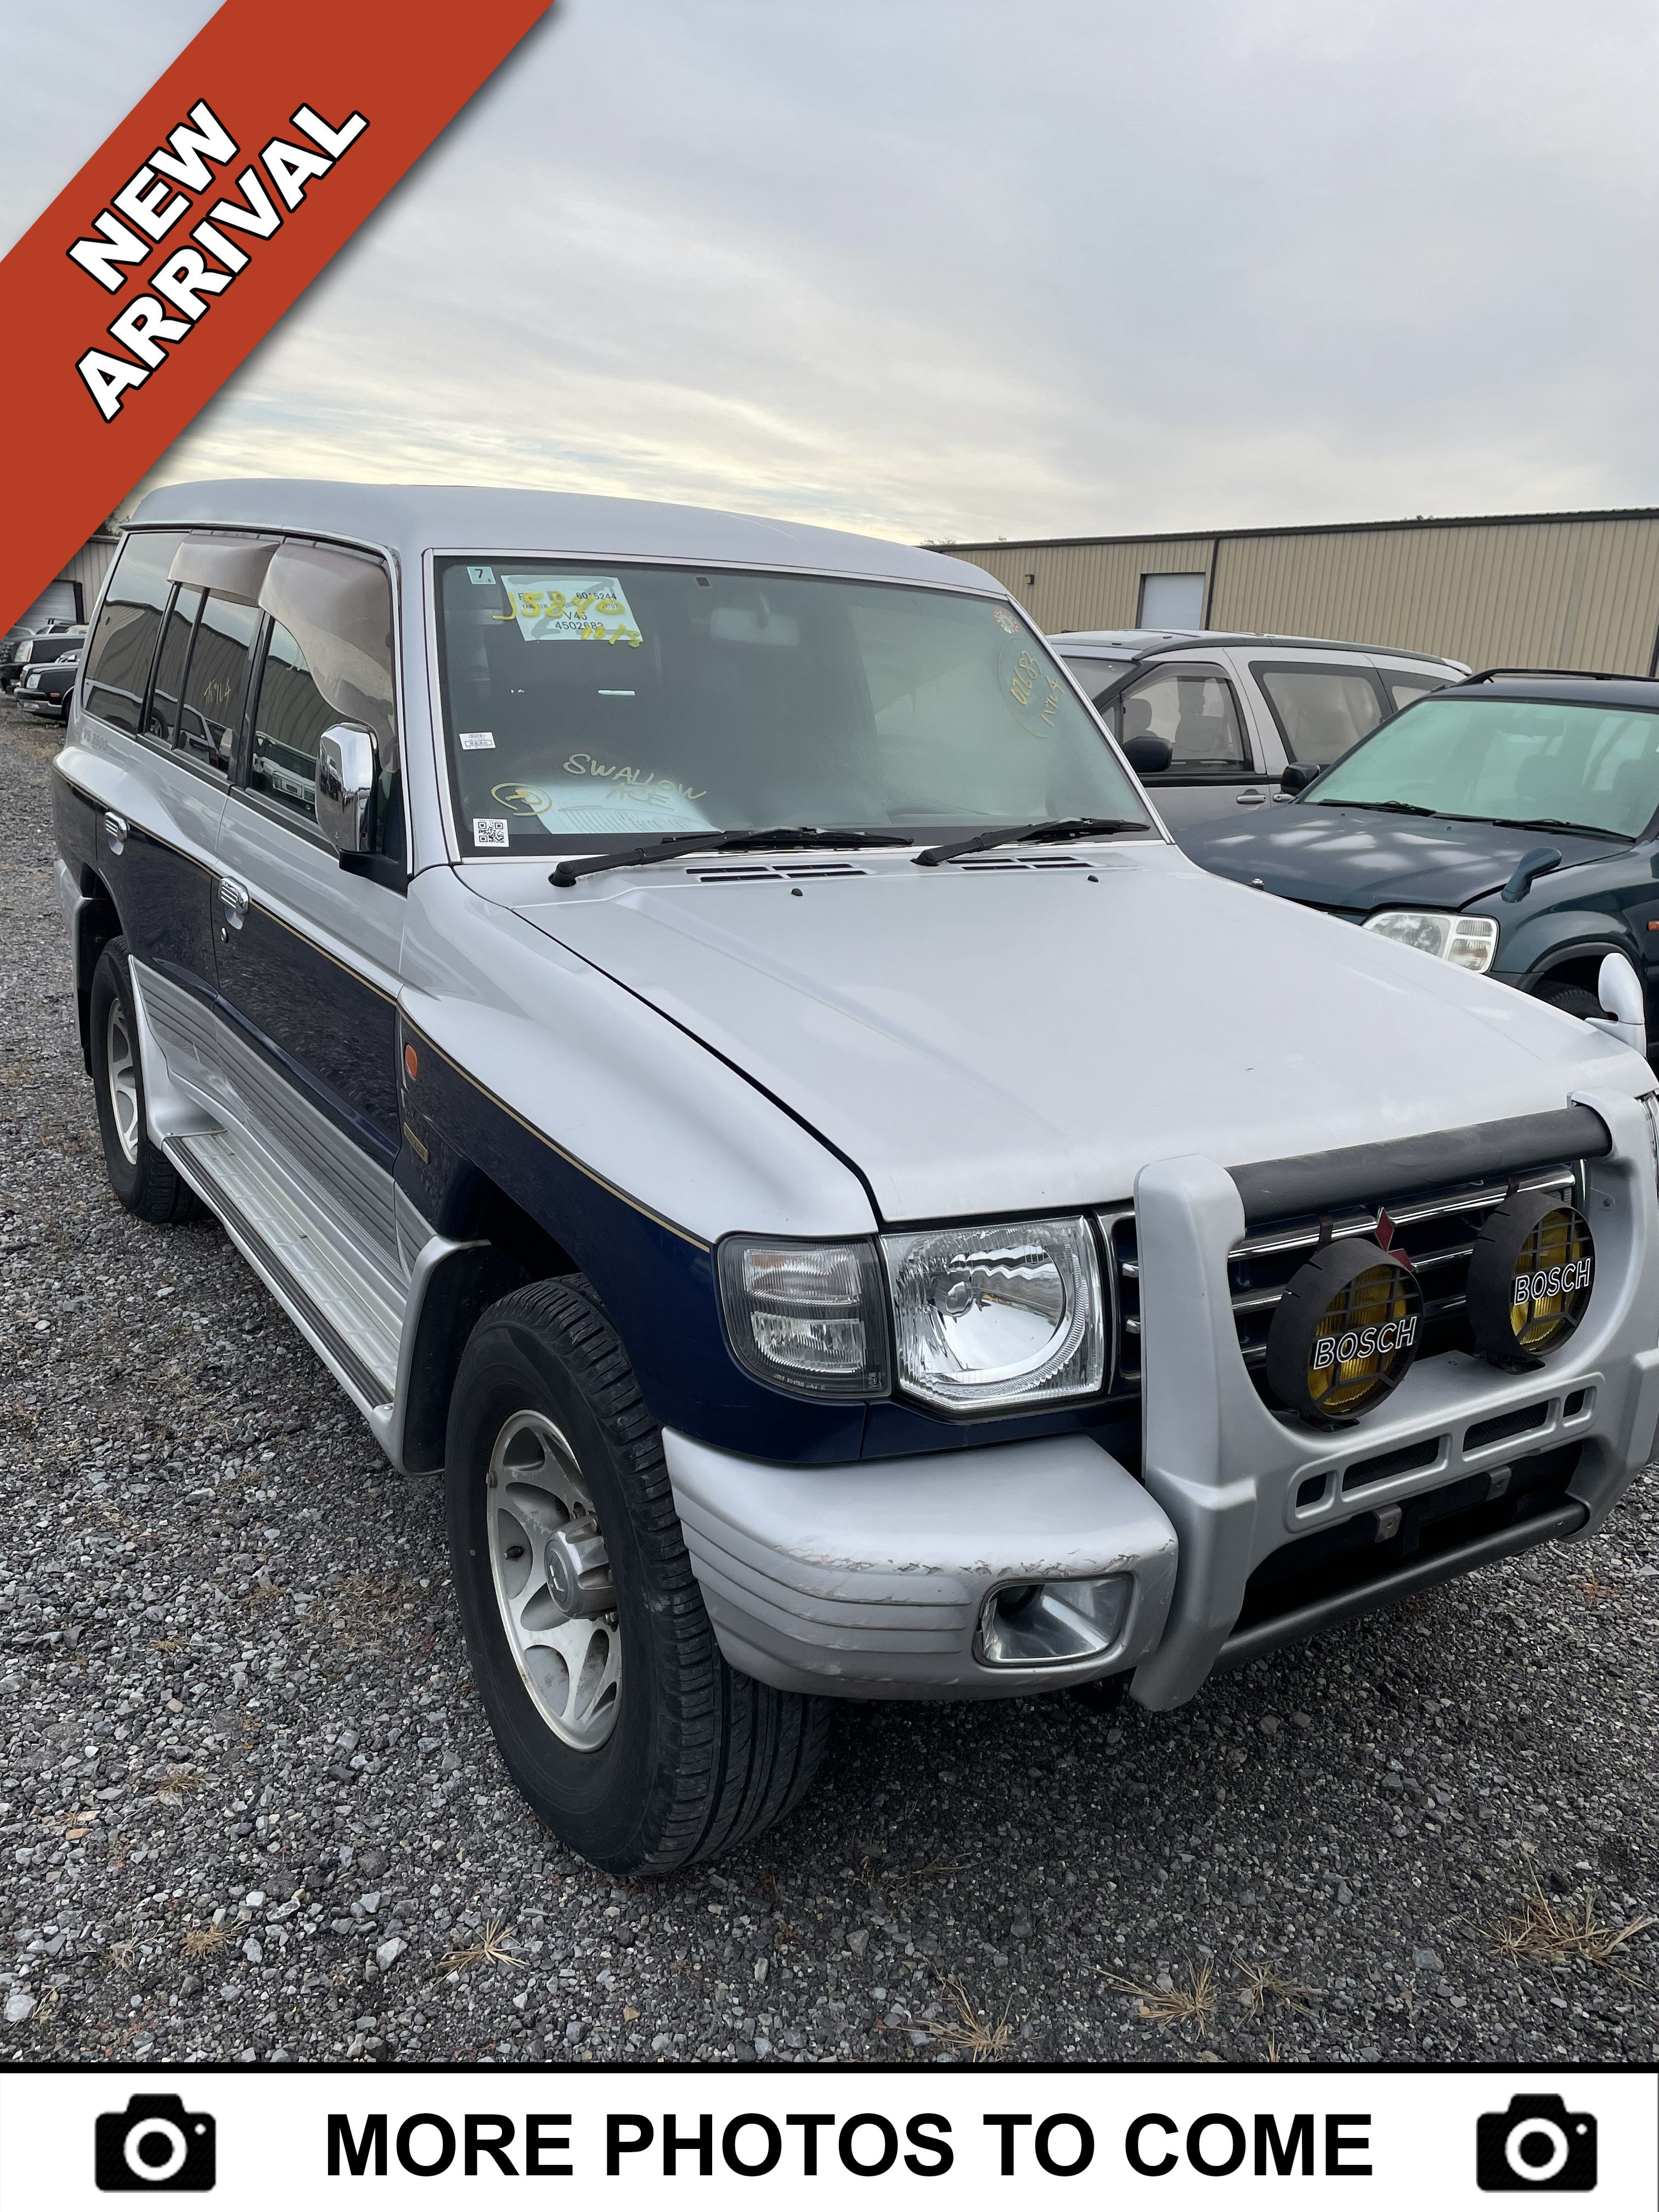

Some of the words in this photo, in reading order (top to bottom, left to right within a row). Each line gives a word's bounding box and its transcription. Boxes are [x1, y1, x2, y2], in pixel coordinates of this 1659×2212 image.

[475, 568, 483, 579] 7
[576, 592, 617, 600] 605244
[563, 753, 707, 799] SWALLOW
[1514, 1258, 1590, 1306] BOSCH
[1313, 1316, 1417, 1370] BOSCH
